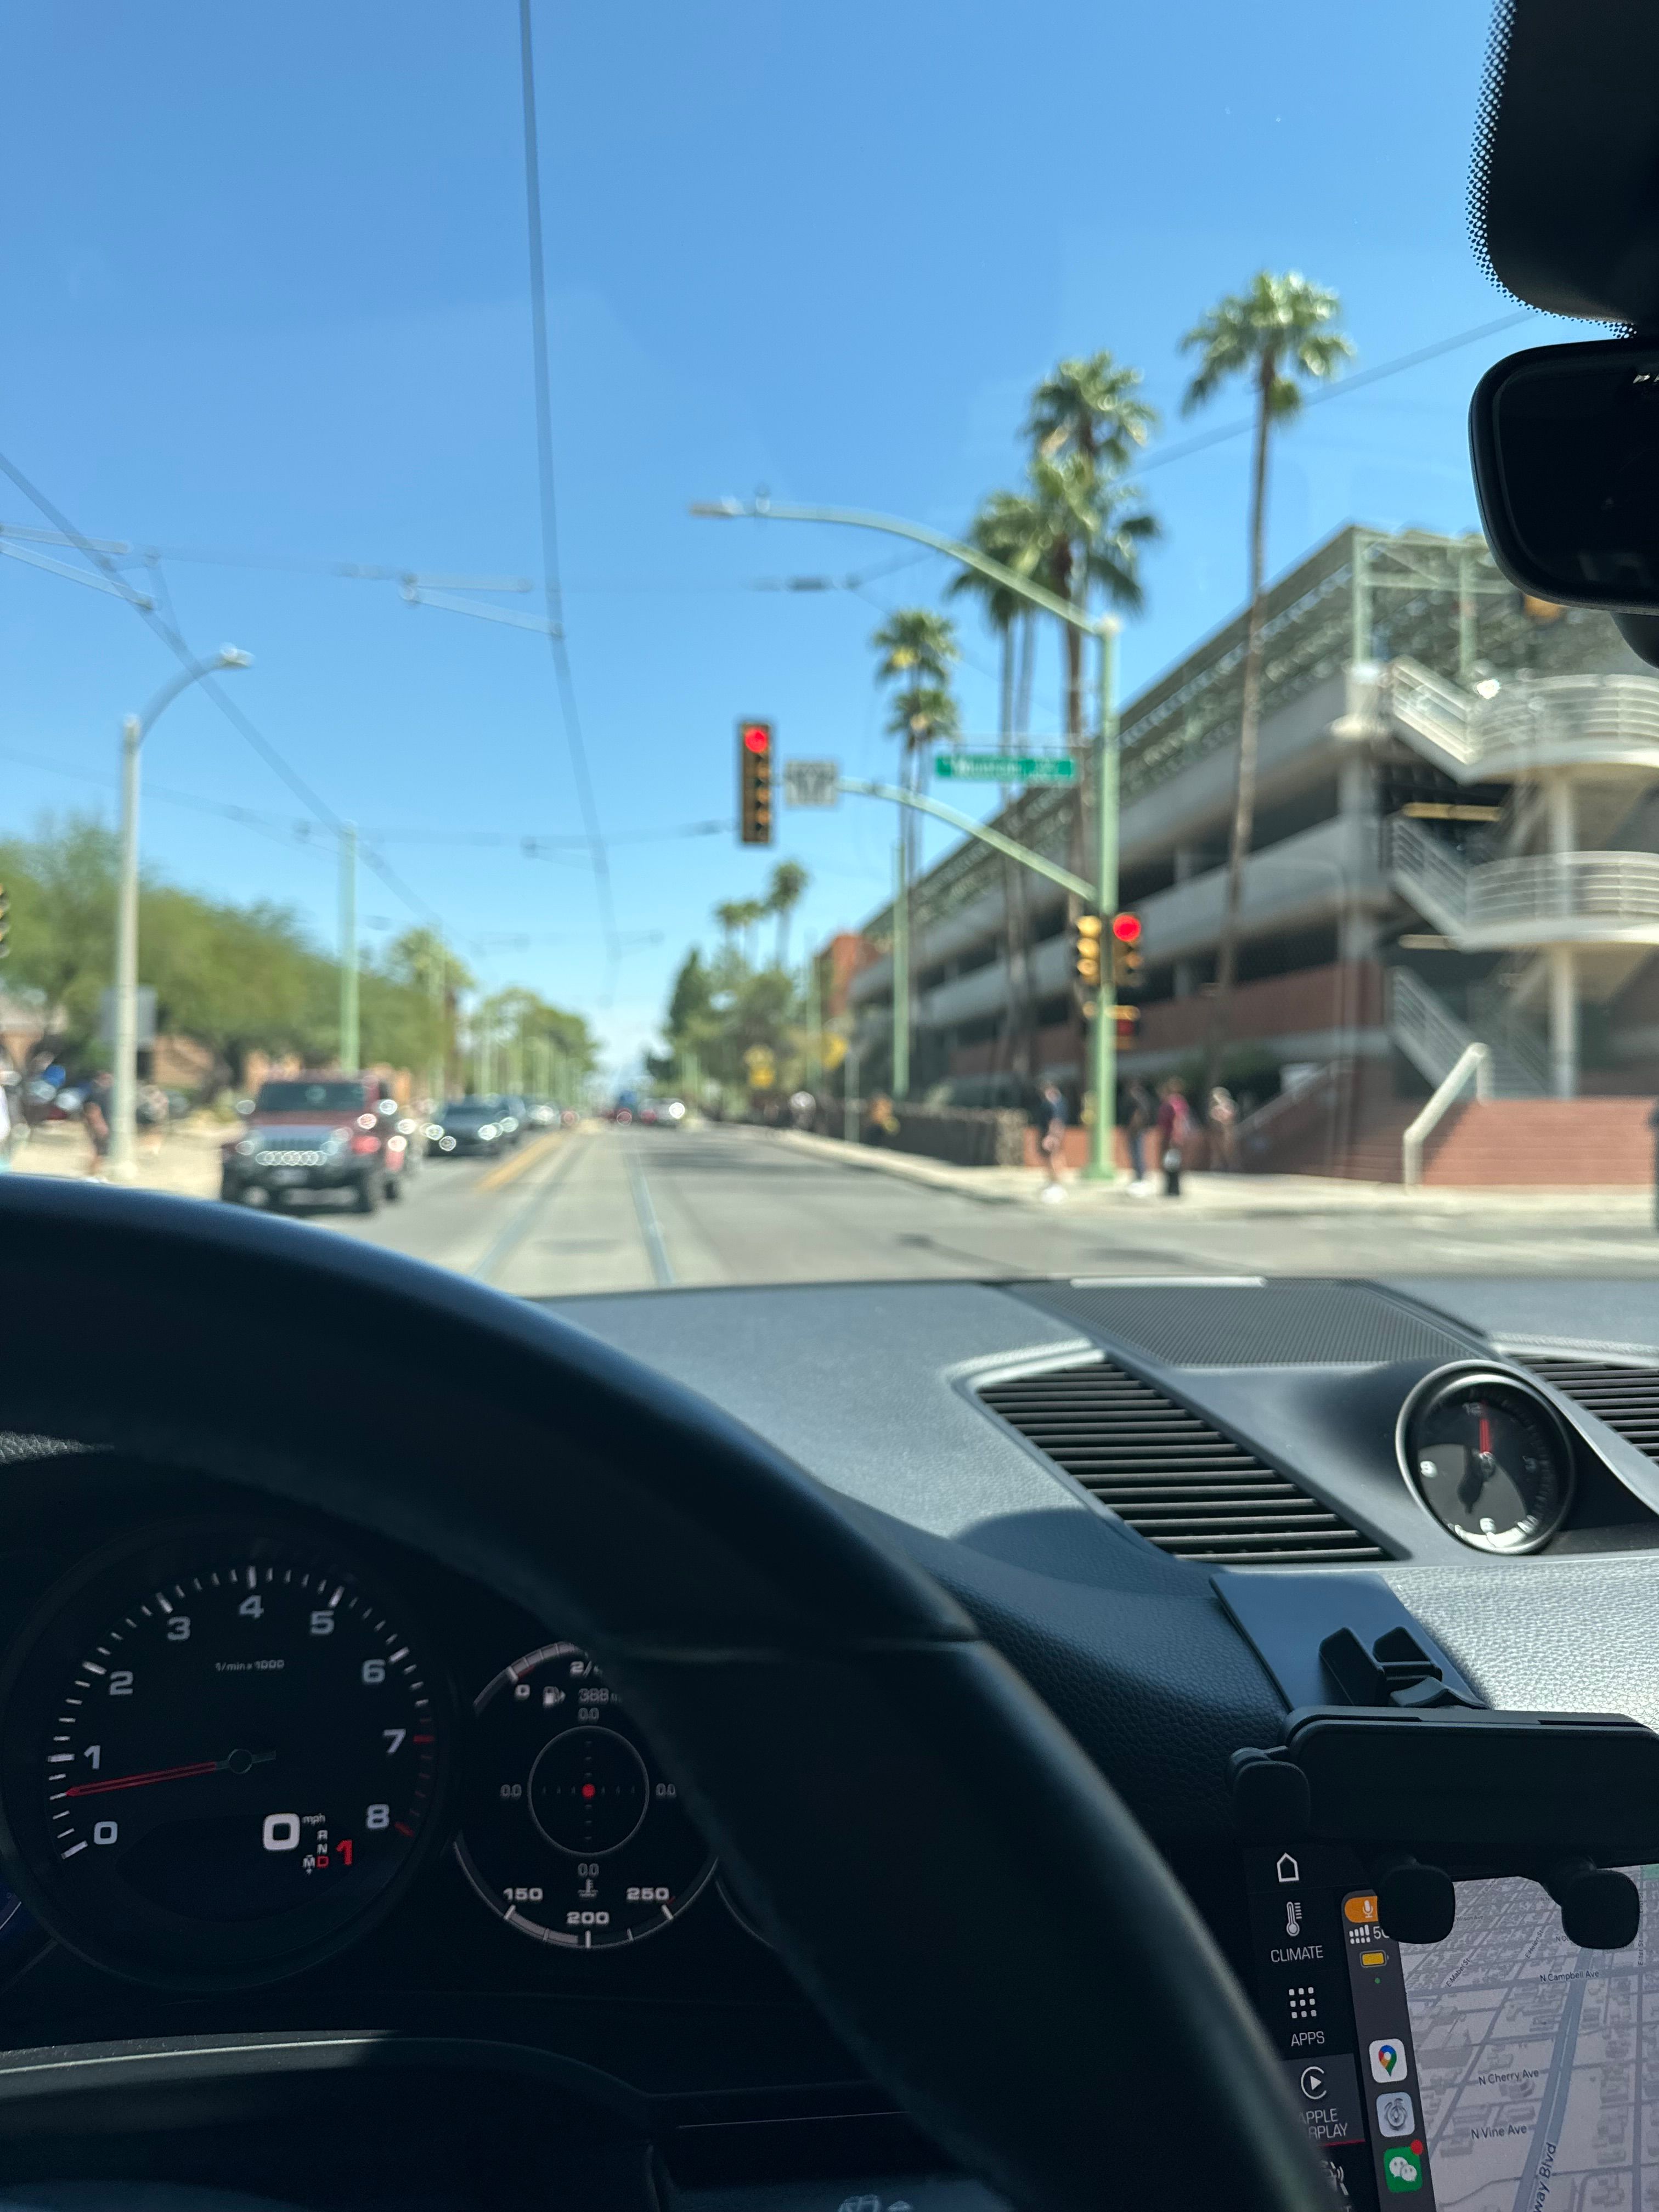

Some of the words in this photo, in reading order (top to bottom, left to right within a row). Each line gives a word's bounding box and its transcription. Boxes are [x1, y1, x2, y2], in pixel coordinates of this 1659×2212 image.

[239, 1595, 264, 1619] 4
[167, 1616, 191, 1640] 3
[311, 1610, 334, 1634] 5
[254, 1660, 285, 1669] 1000
[362, 1660, 385, 1683] 6
[109, 1671, 133, 1695] 2
[515, 1684, 531, 1699] 0
[383, 1729, 406, 1754] 7
[84, 1745, 101, 1769] 1
[366, 1804, 390, 1829] 8
[93, 1820, 118, 1844] 0
[263, 1813, 301, 1850] 0
[302, 1813, 326, 1826] mph
[317, 1843, 328, 1854] N
[336, 1839, 352, 1865] 1
[316, 1855, 329, 1869] D
[503, 1888, 543, 1901] 150
[627, 1887, 669, 1901] 250
[567, 1911, 610, 1925] 200
[1271, 1945, 1324, 1962] CLIMATE
[1527, 1938, 1540, 1954] Helen
[1449, 1964, 1465, 1983] Mabel
[1463, 1957, 1471, 1966] St
[1548, 1971, 1583, 1982] Campbell
[1291, 2031, 1325, 2047] APPS
[1478, 2076, 1486, 2085] N
[1488, 2072, 1520, 2085] Cherry
[1522, 2069, 1539, 2078] Ave
[1299, 2108, 1338, 2125] APPLE
[1308, 2123, 1347, 2140] RPLAY
[1471, 2129, 1480, 2140] N
[1481, 2126, 1505, 2138] Vine
[1508, 2124, 1527, 2136] Ave
[1539, 2142, 1557, 2179] Blvd
